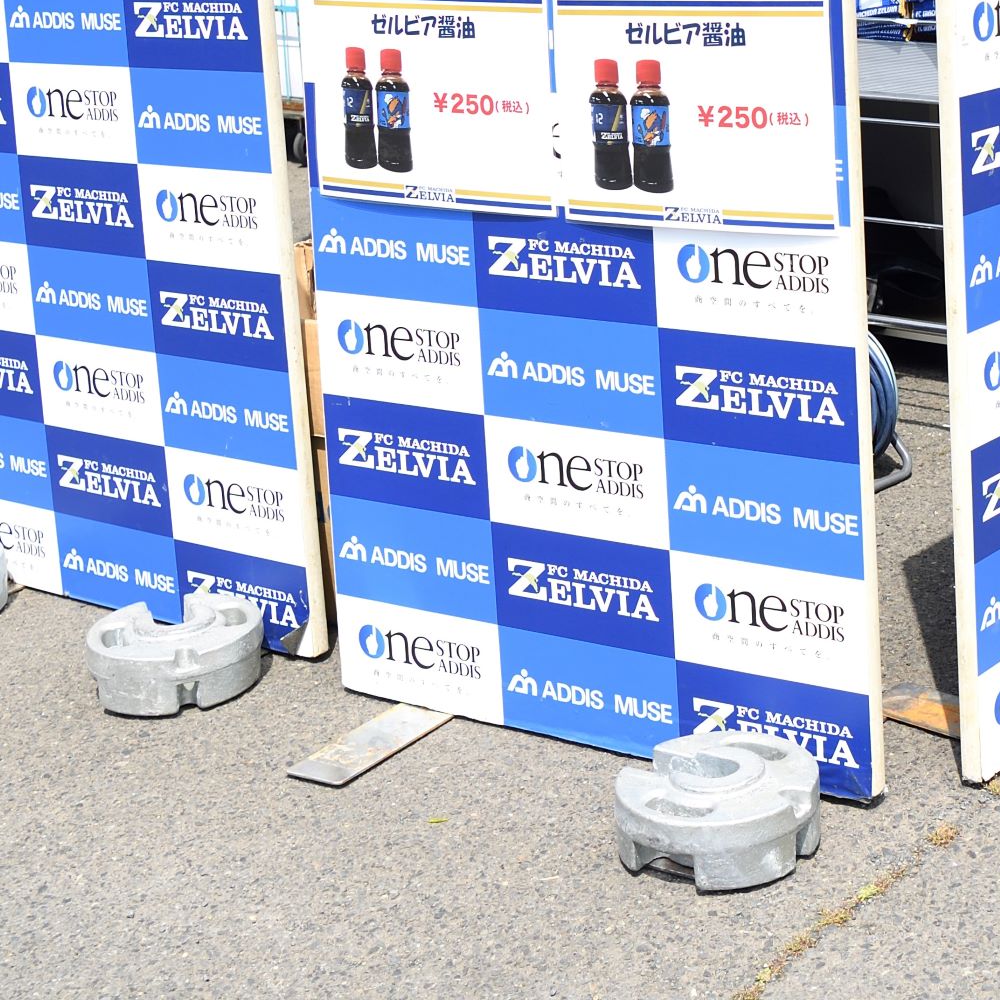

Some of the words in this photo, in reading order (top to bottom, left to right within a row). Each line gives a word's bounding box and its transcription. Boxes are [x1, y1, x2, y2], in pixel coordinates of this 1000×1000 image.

[162, 1, 180, 13] FC
[182, 1, 244, 15] MACHIDA
[32, 11, 75, 31] ADDIS
[80, 11, 122, 32] MUSE
[132, 1, 250, 42] ZELVIA
[371, 13, 476, 40] ゼルビア醤油
[625, 21, 747, 48] ゼルビア醤油
[83, 88, 118, 107] STOP
[86, 105, 119, 123] ADDIS
[163, 111, 211, 133] ADDIS
[217, 114, 264, 137] MUSE
[29, 183, 135, 230] ZELVIA
[56, 186, 72, 199] FC
[74, 187, 129, 204] MACHIDA
[405, 184, 456, 204] ZELVIA
[664, 205, 723, 226] ZELVIA
[350, 236, 408, 261] ADDIS
[416, 242, 471, 268] MUSE
[487, 234, 642, 290] ZELVIA
[527, 238, 550, 253] FC
[553, 240, 636, 261] MACHIDA
[773, 251, 830, 277] STOP
[775, 274, 831, 296] ADDIS
[159, 290, 276, 342] ZELVIA
[188, 294, 206, 307] FC
[208, 295, 269, 315] MACHIDA
[414, 327, 461, 351] STOP
[416, 348, 462, 367] ADDIS
[522, 360, 586, 388] ADDIS
[595, 369, 656, 397] MUSE
[718, 369, 744, 384] FC
[748, 372, 839, 396] MACHIDA
[674, 364, 846, 427] ZELVIA
[190, 402, 238, 425] ADDIS
[244, 408, 290, 434] MUSE
[711, 495, 783, 526] ADDIS
[792, 506, 860, 538] MUSE
[369, 545, 428, 574] ADDIS
[436, 556, 491, 586] MUSE
[789, 597, 846, 625] STOP
[791, 619, 846, 644] ADDIS
